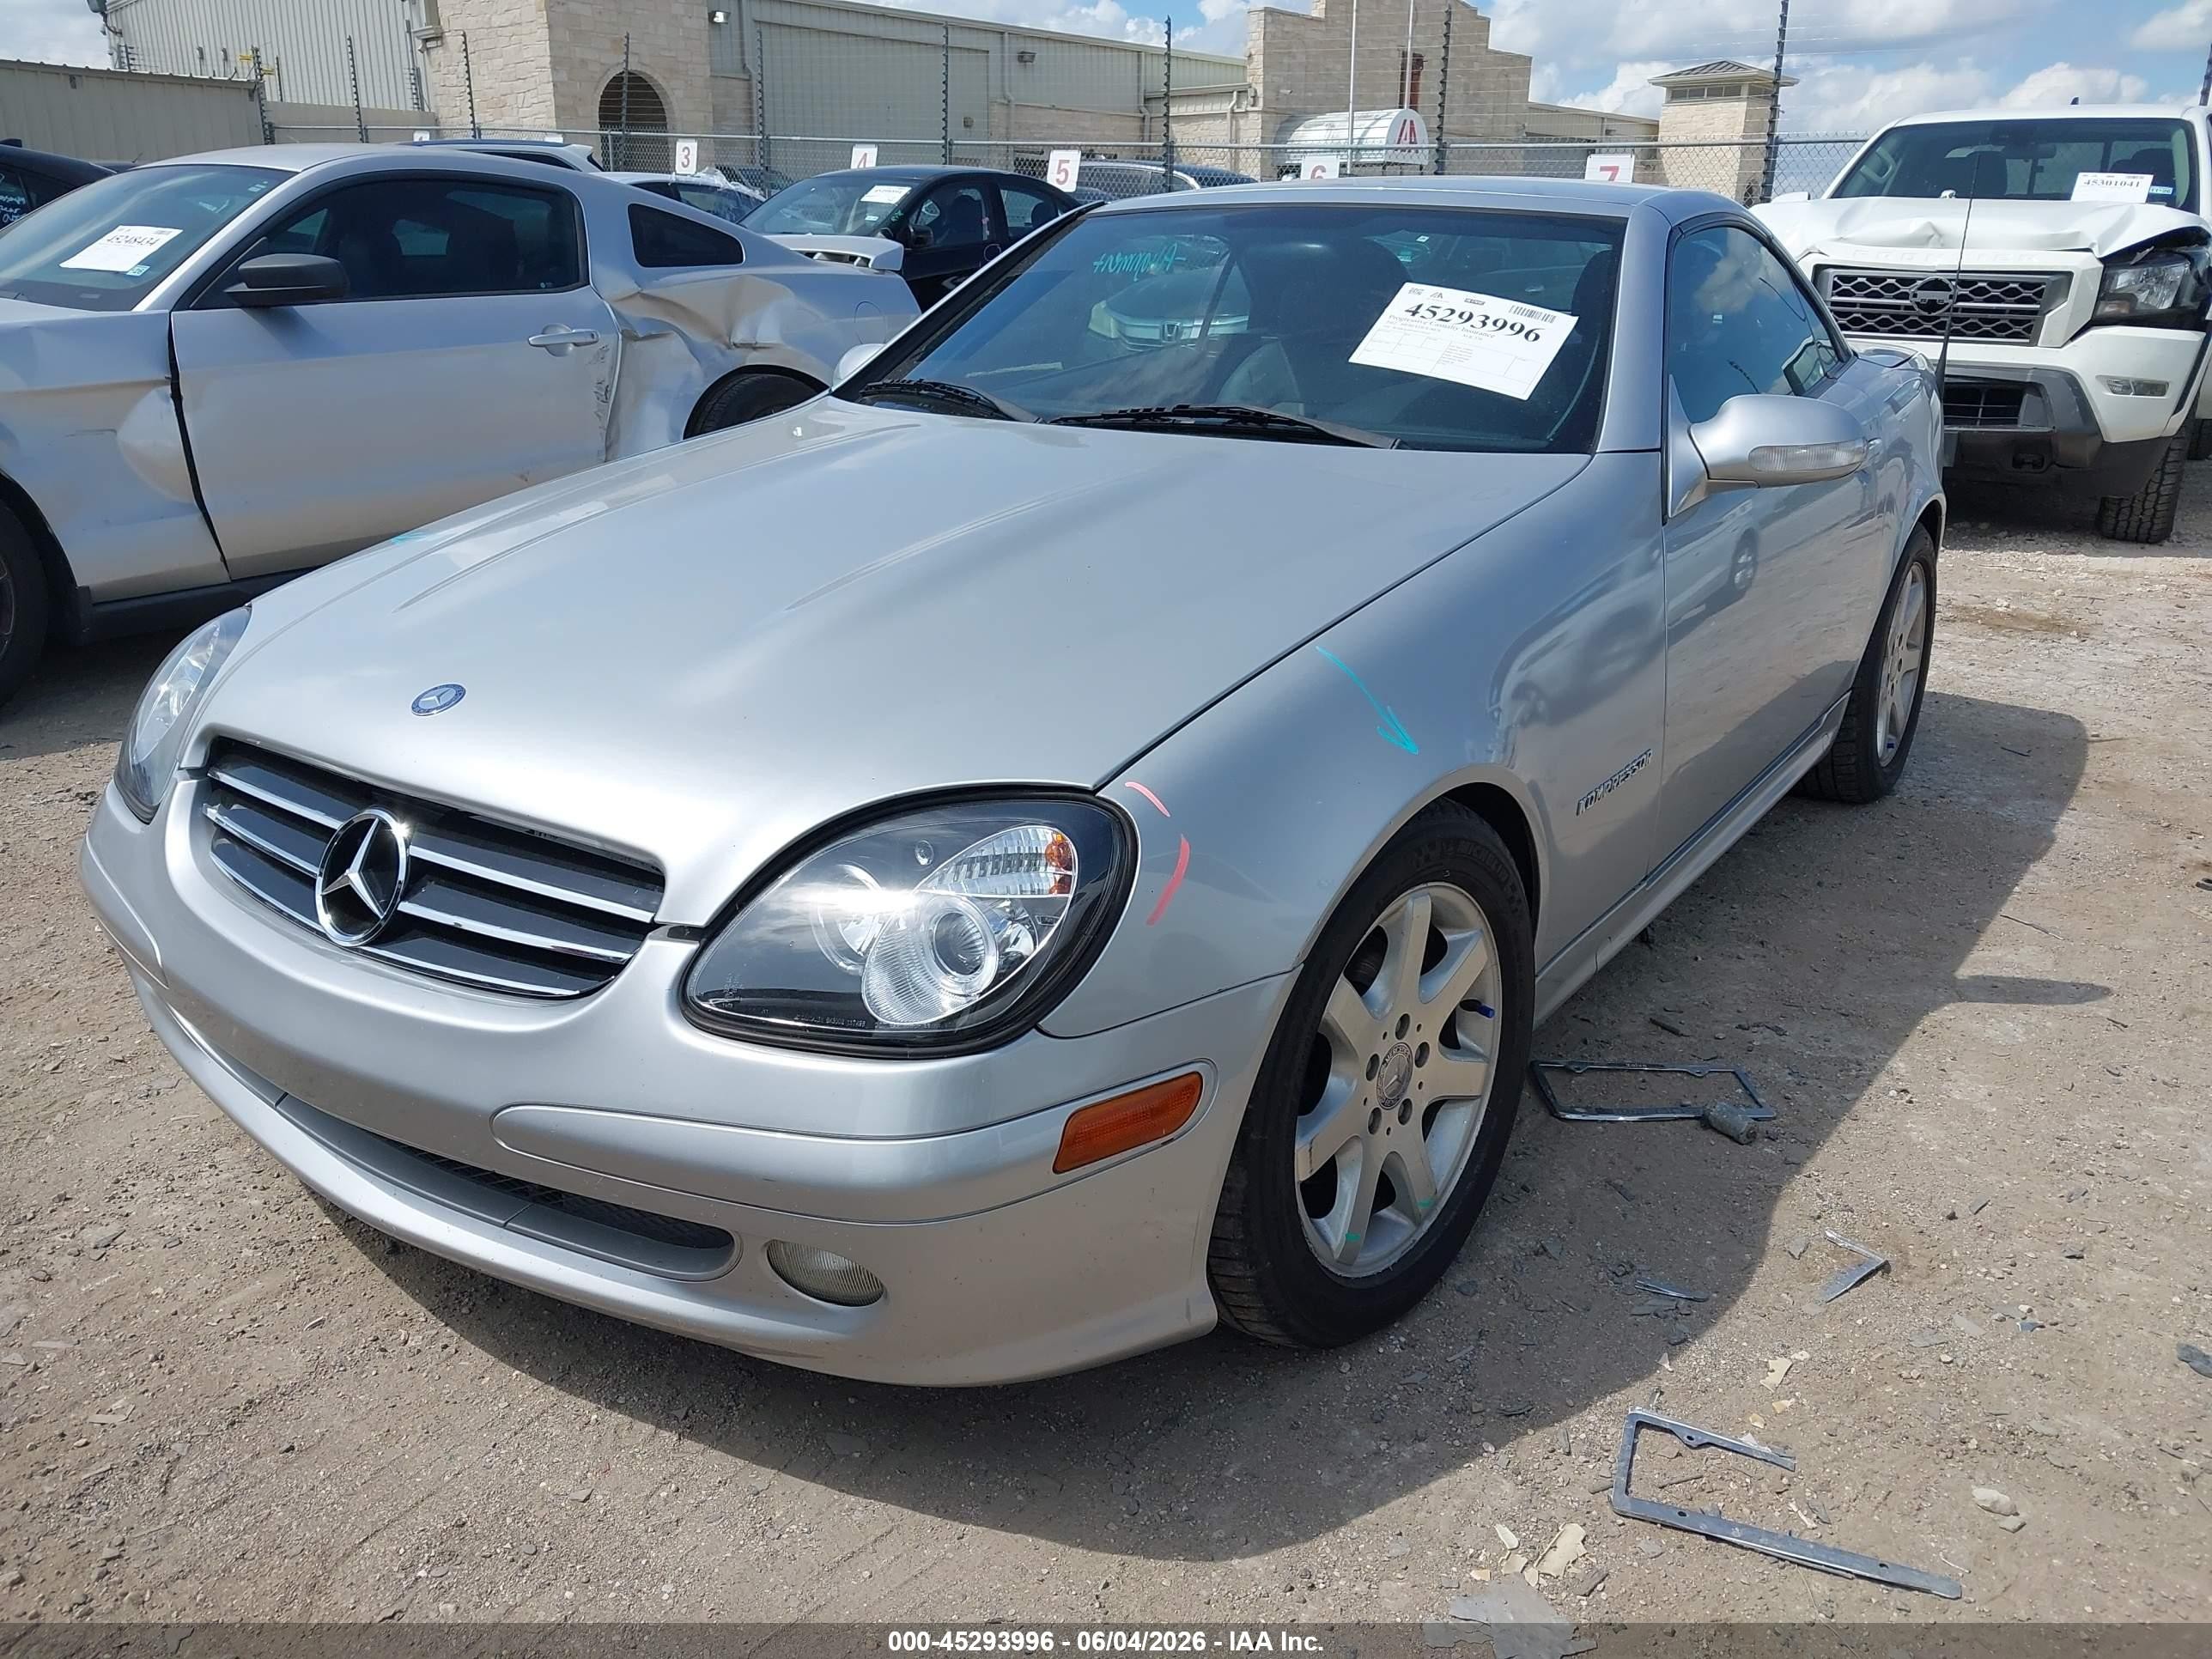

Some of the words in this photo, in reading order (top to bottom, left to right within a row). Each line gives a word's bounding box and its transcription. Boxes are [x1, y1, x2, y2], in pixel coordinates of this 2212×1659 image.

[680, 146, 691, 169] 3
[857, 152, 868, 169] 4
[1055, 159, 1071, 185] 5
[1599, 165, 1620, 182] 7
[2083, 178, 2142, 188] 45301041
[1404, 302, 1547, 343] 45293996
[1461, 325, 1497, 339] Insurance
[1576, 748, 1653, 817] KOMPRESSOR
